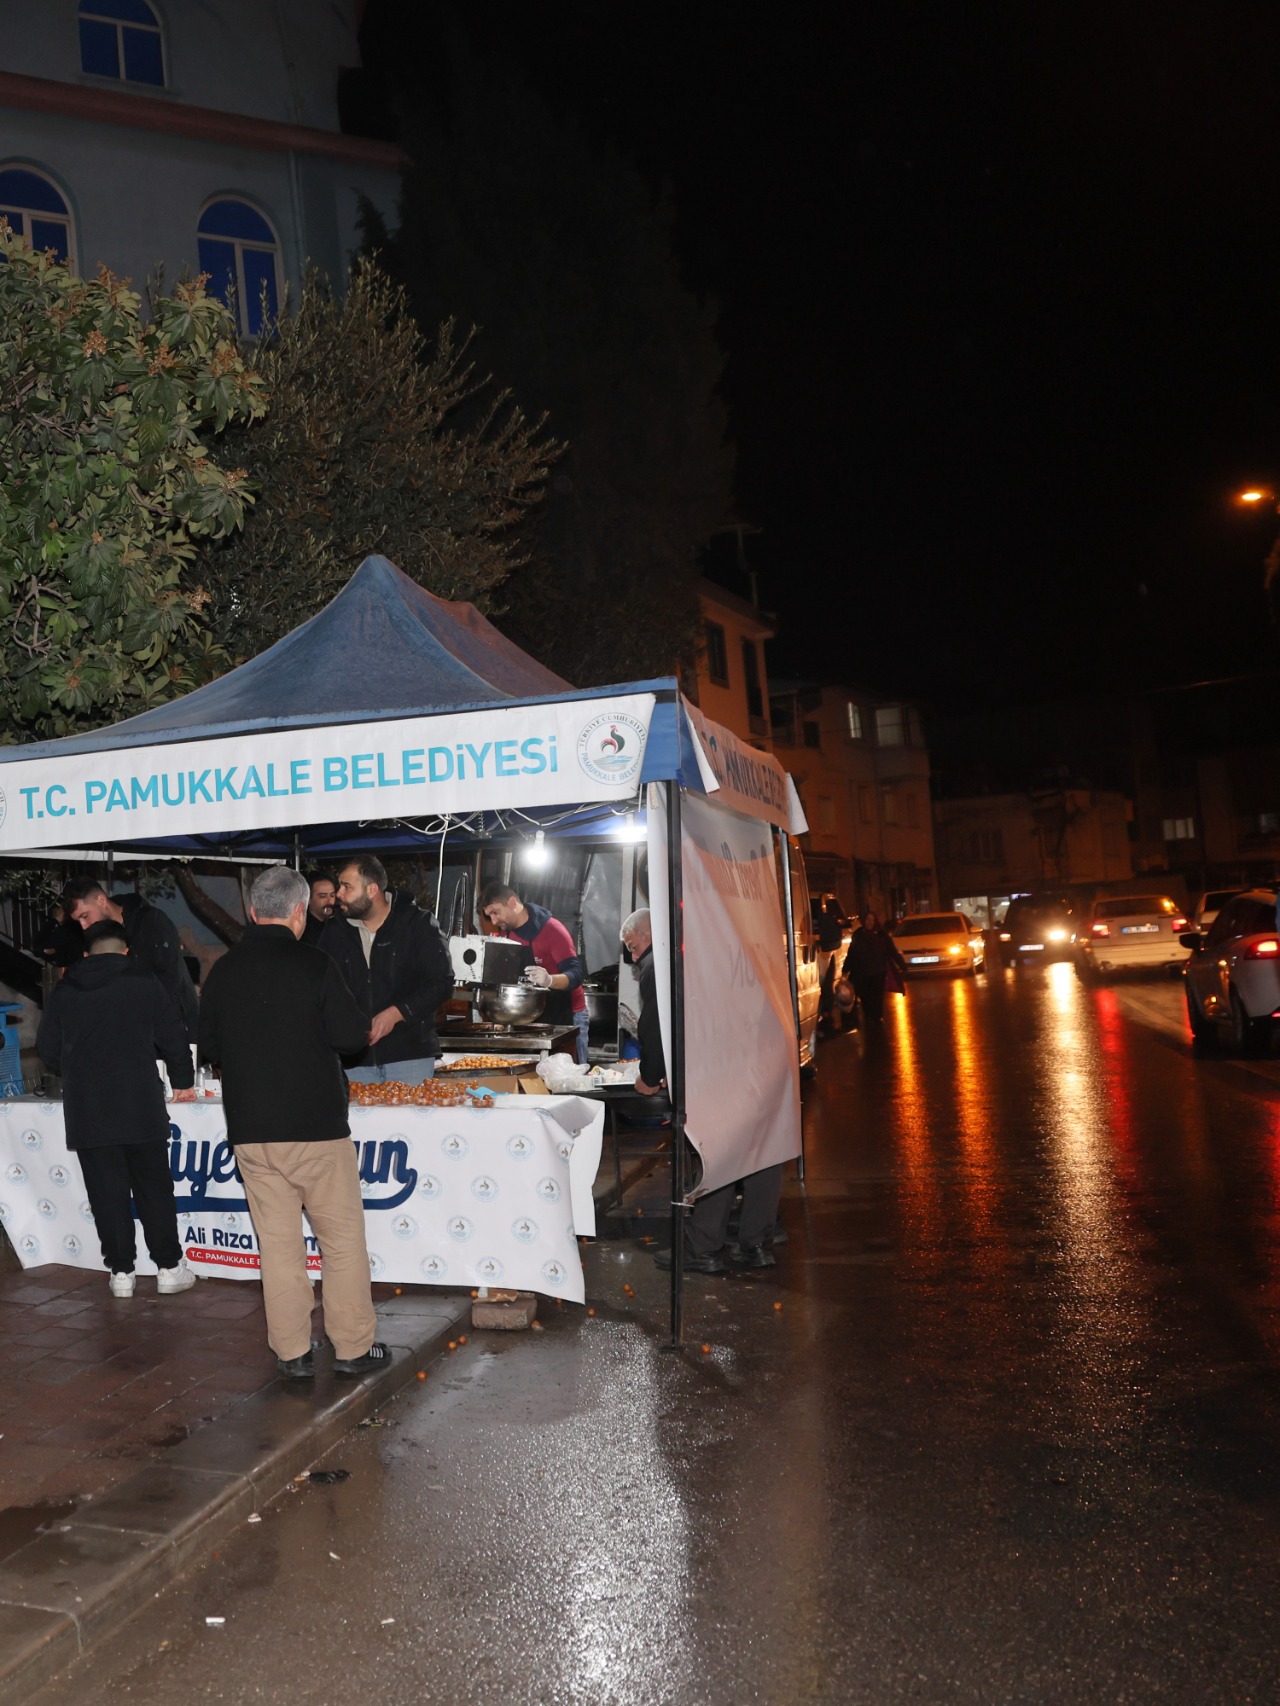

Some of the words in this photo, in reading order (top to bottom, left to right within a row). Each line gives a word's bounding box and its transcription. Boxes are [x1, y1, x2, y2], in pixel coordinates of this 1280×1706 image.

[20, 785, 77, 820] T.C.
[86, 760, 314, 814] PAMUKKALE
[324, 735, 559, 793] BELEDİYESİ
[185, 1226, 206, 1244] Ali
[205, 1252, 255, 1265] PAMUKKALE
